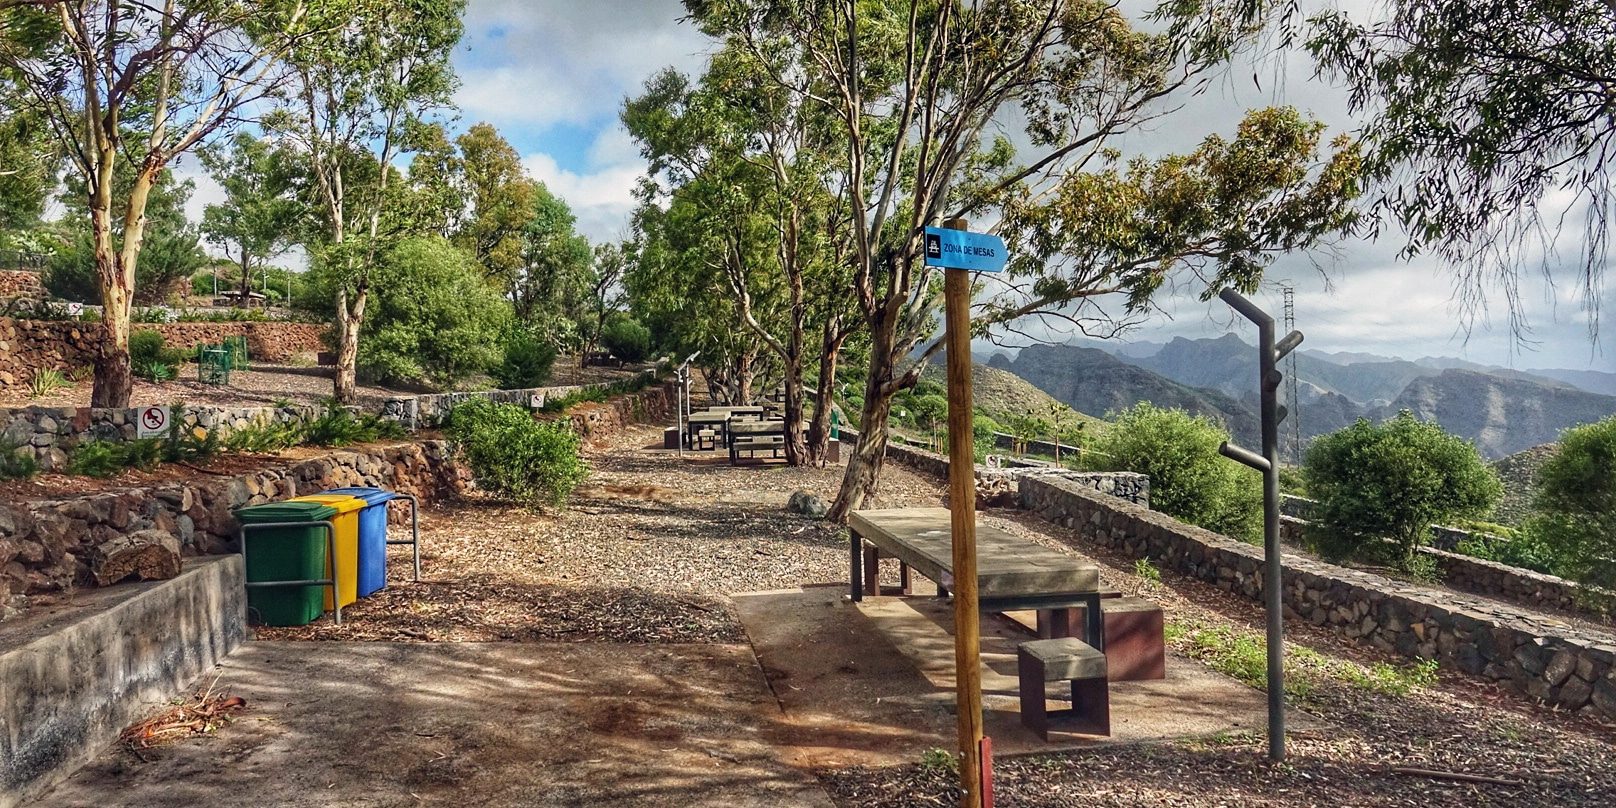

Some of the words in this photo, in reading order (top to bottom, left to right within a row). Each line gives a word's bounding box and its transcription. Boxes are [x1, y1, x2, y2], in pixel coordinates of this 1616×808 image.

[944, 243, 962, 253] ZONA
[964, 246, 972, 255] DE
[973, 247, 995, 257] MESAS
